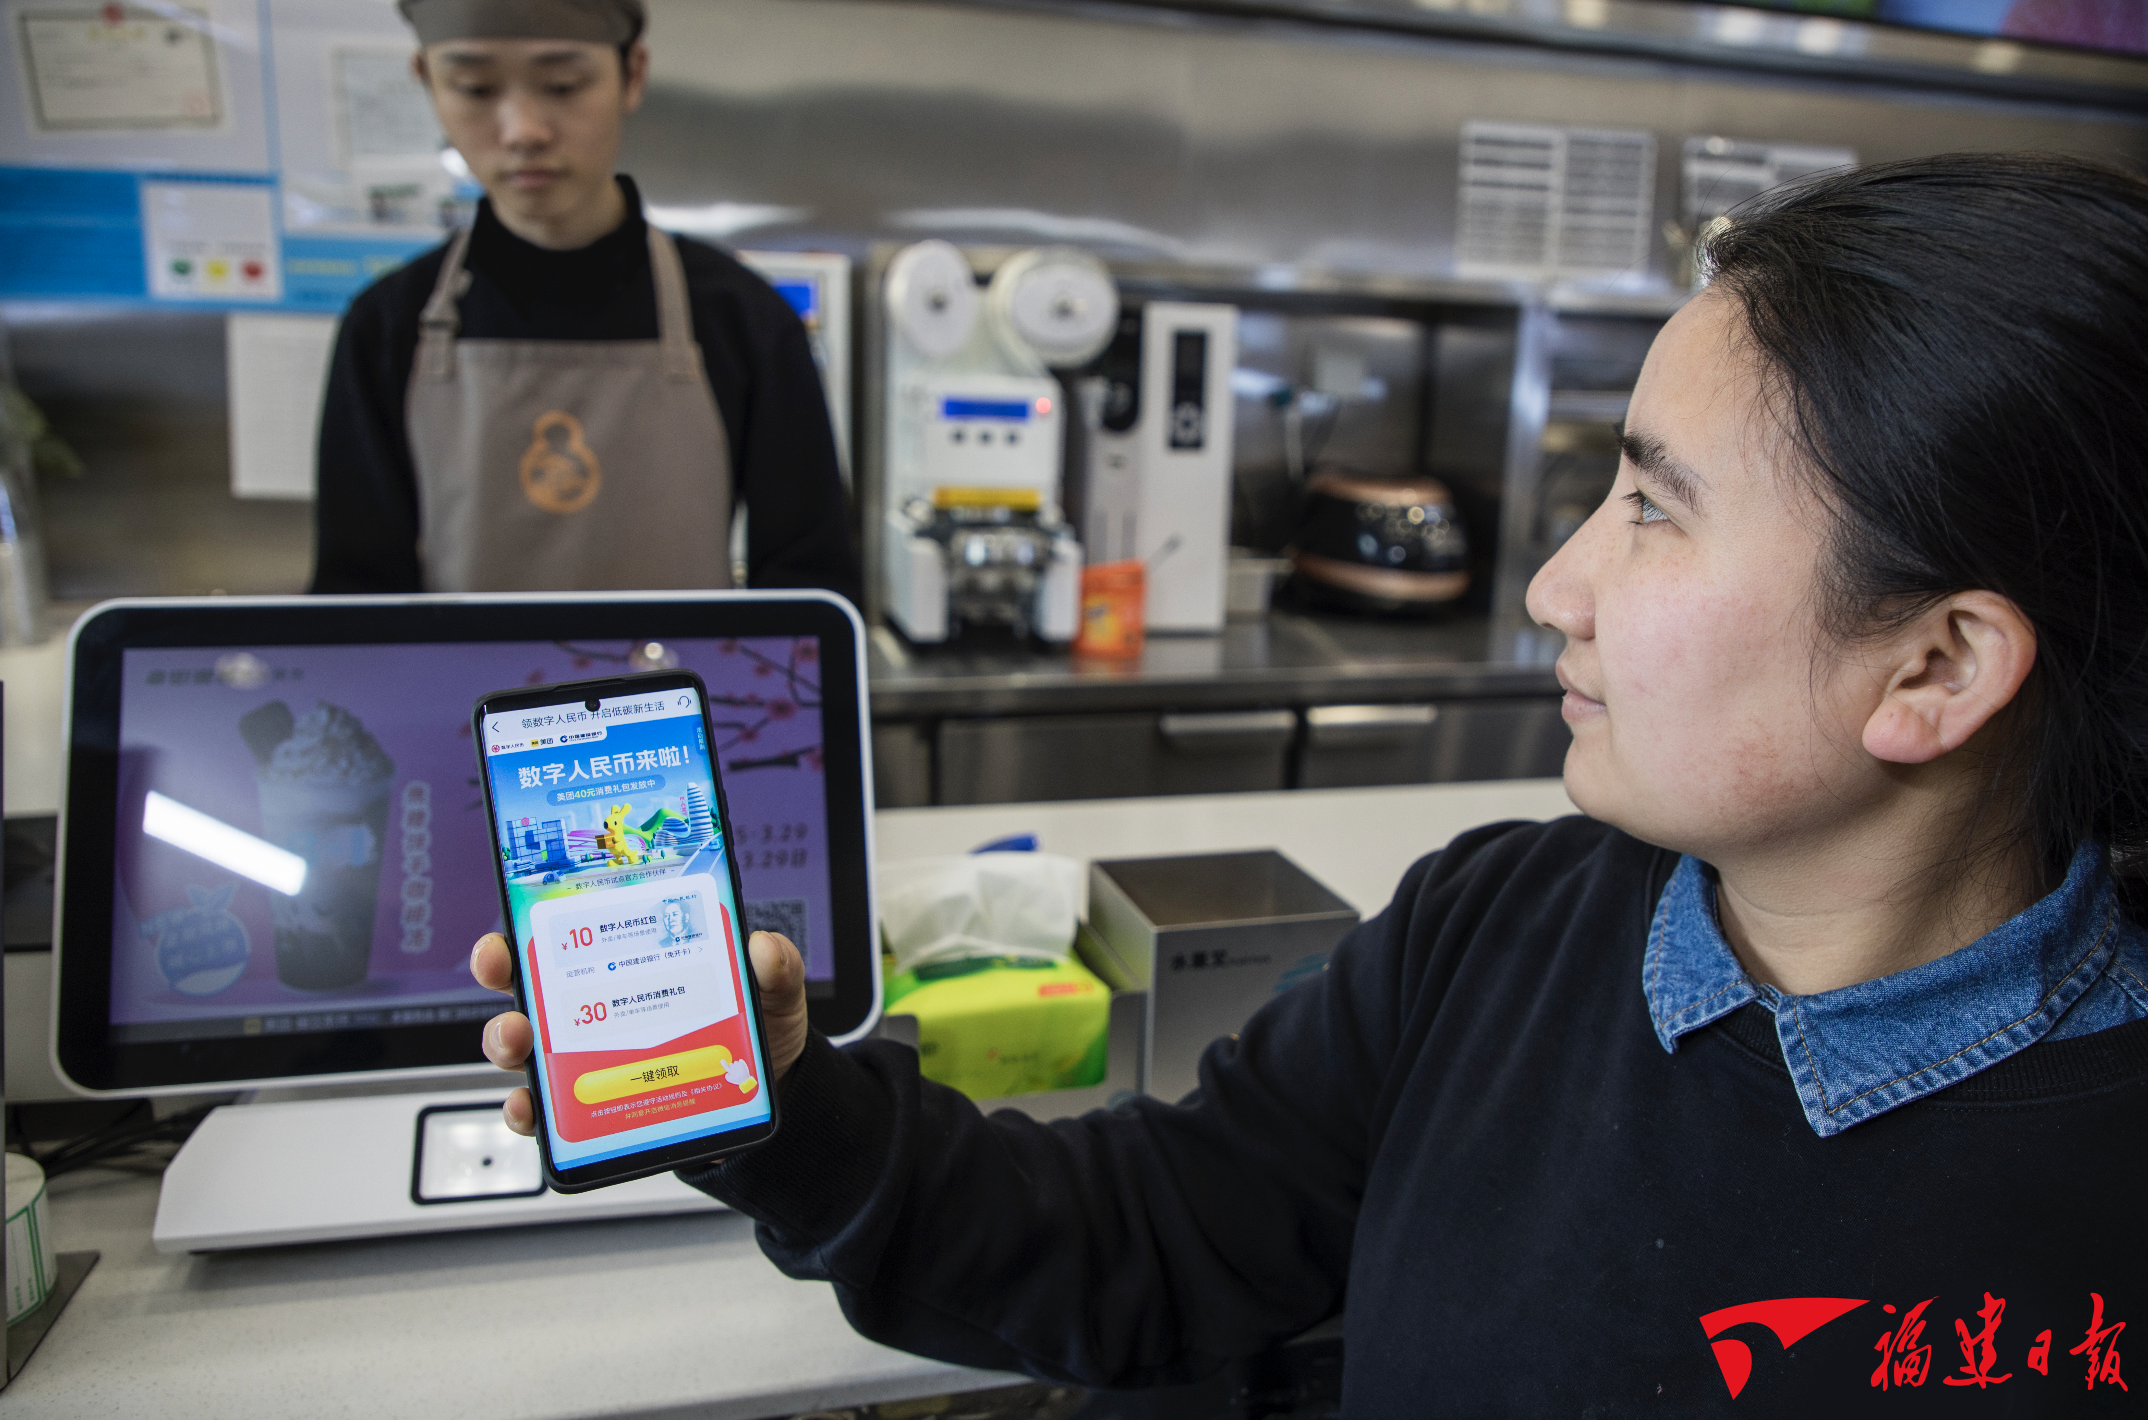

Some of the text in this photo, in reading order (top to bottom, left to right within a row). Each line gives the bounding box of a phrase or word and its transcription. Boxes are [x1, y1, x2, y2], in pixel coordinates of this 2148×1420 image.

[521, 701, 665, 729] 领数字人民币 开启低碳新生活
[518, 745, 690, 790] 数字人民币来啦！
[556, 779, 656, 802] 美团40元消费礼包发放中
[599, 915, 657, 933] 数字人民币红包
[611, 986, 686, 1008] 数字人民币消费礼包
[630, 1065, 680, 1083] 一键领取
